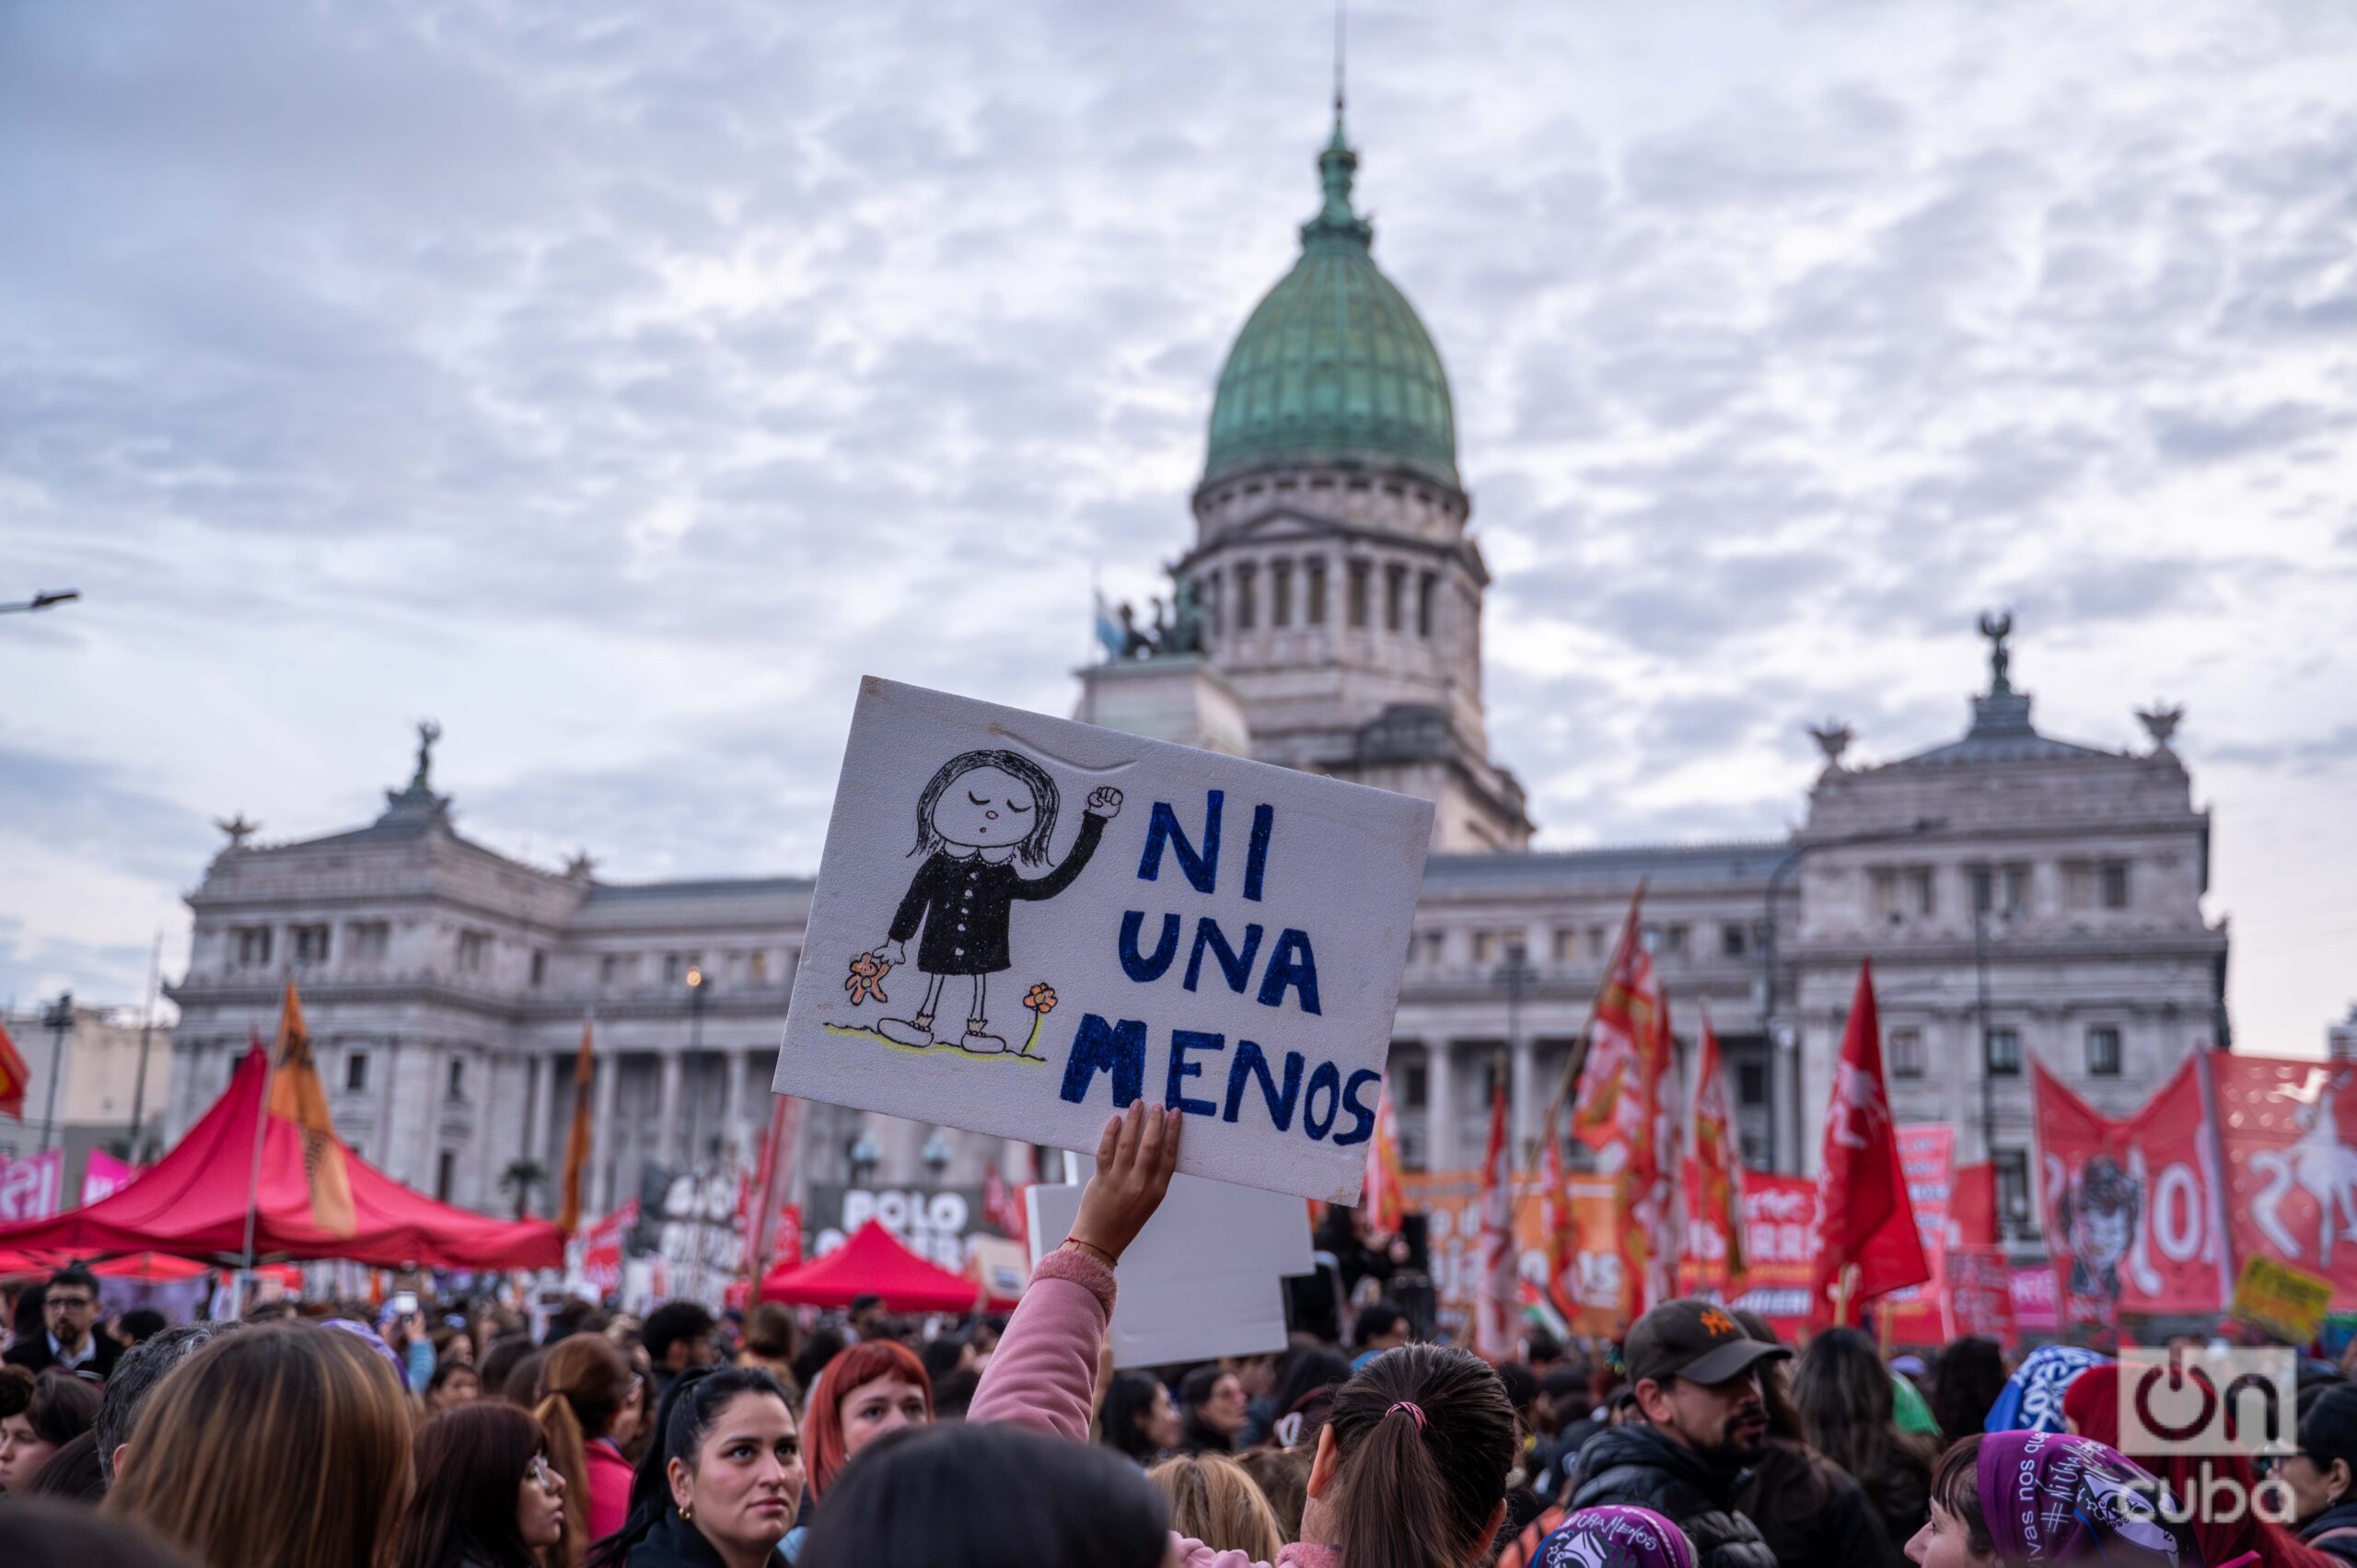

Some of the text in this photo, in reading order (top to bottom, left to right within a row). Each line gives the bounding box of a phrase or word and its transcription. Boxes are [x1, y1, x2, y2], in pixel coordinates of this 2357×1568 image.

[1137, 790, 1273, 901] NI
[1119, 911, 1322, 1015] UNA
[1060, 1013, 1381, 1145] MENOS
[843, 1190, 969, 1236] POLO
[2019, 1431, 2051, 1563] ivas nos que
